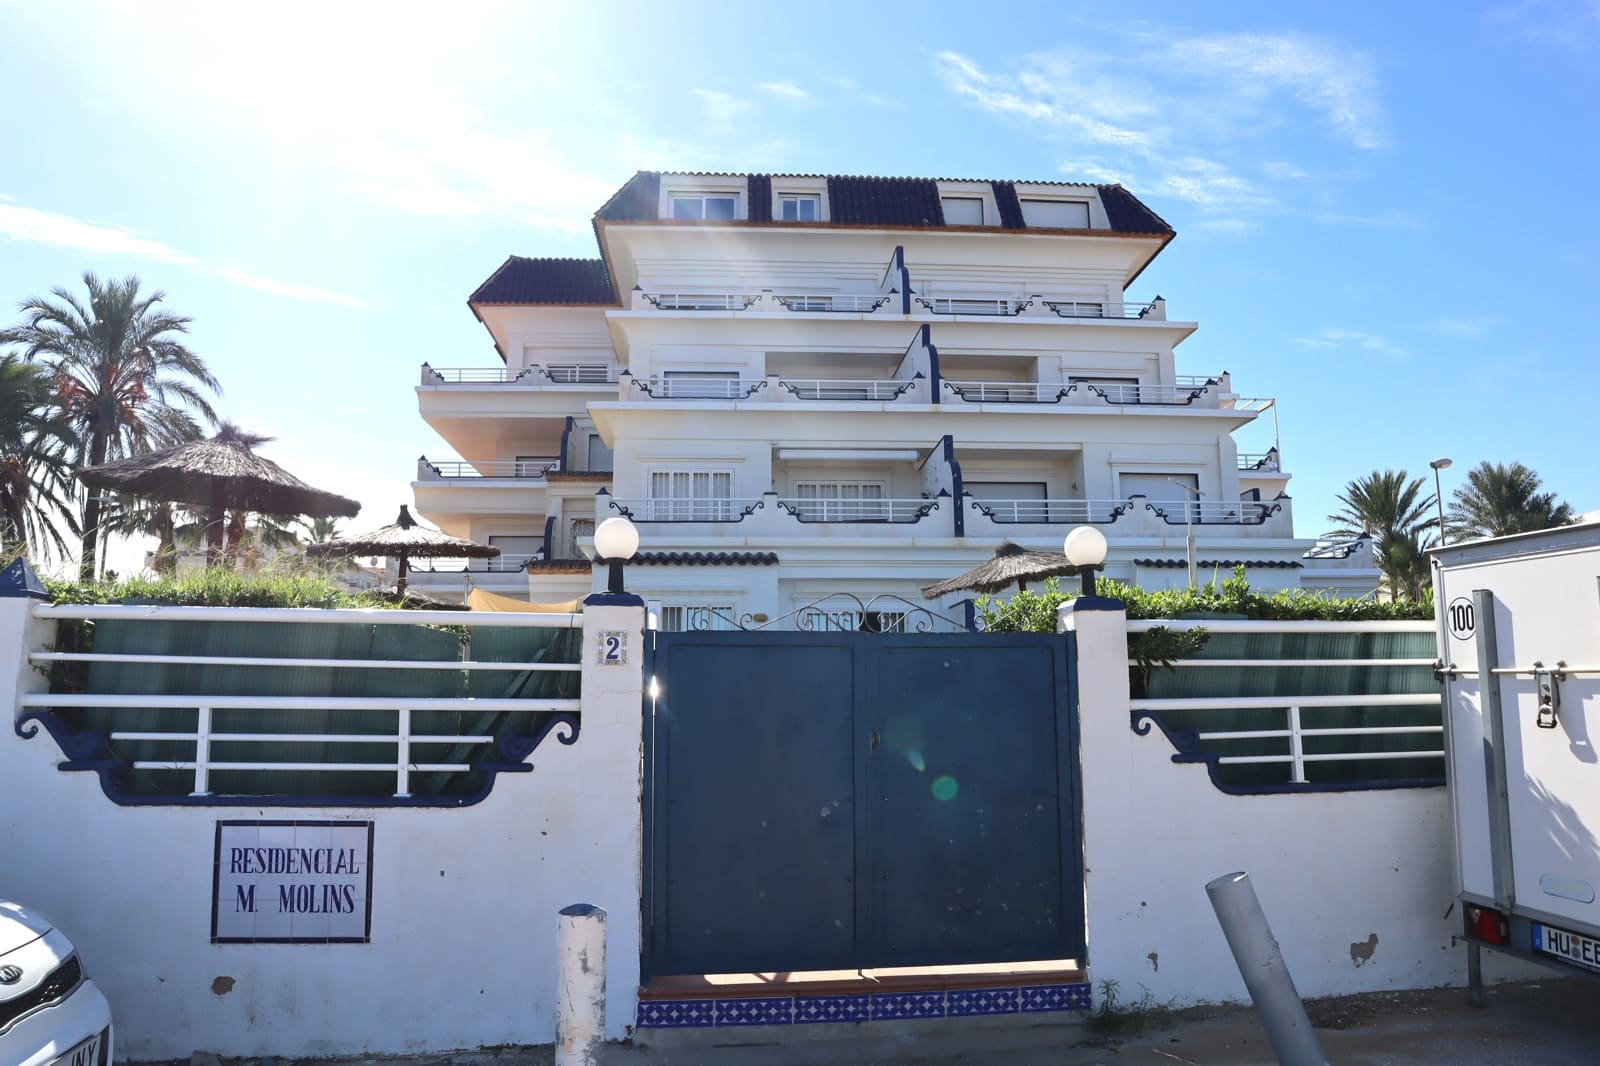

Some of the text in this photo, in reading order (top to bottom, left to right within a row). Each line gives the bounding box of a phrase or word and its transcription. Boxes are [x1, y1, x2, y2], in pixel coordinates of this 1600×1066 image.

[1450, 604, 1475, 632] 100
[606, 637, 620, 660] 2
[230, 847, 360, 875] RESIDENCIAL
[235, 884, 356, 914] M. MOLINS
[1547, 929, 1570, 956] HU
